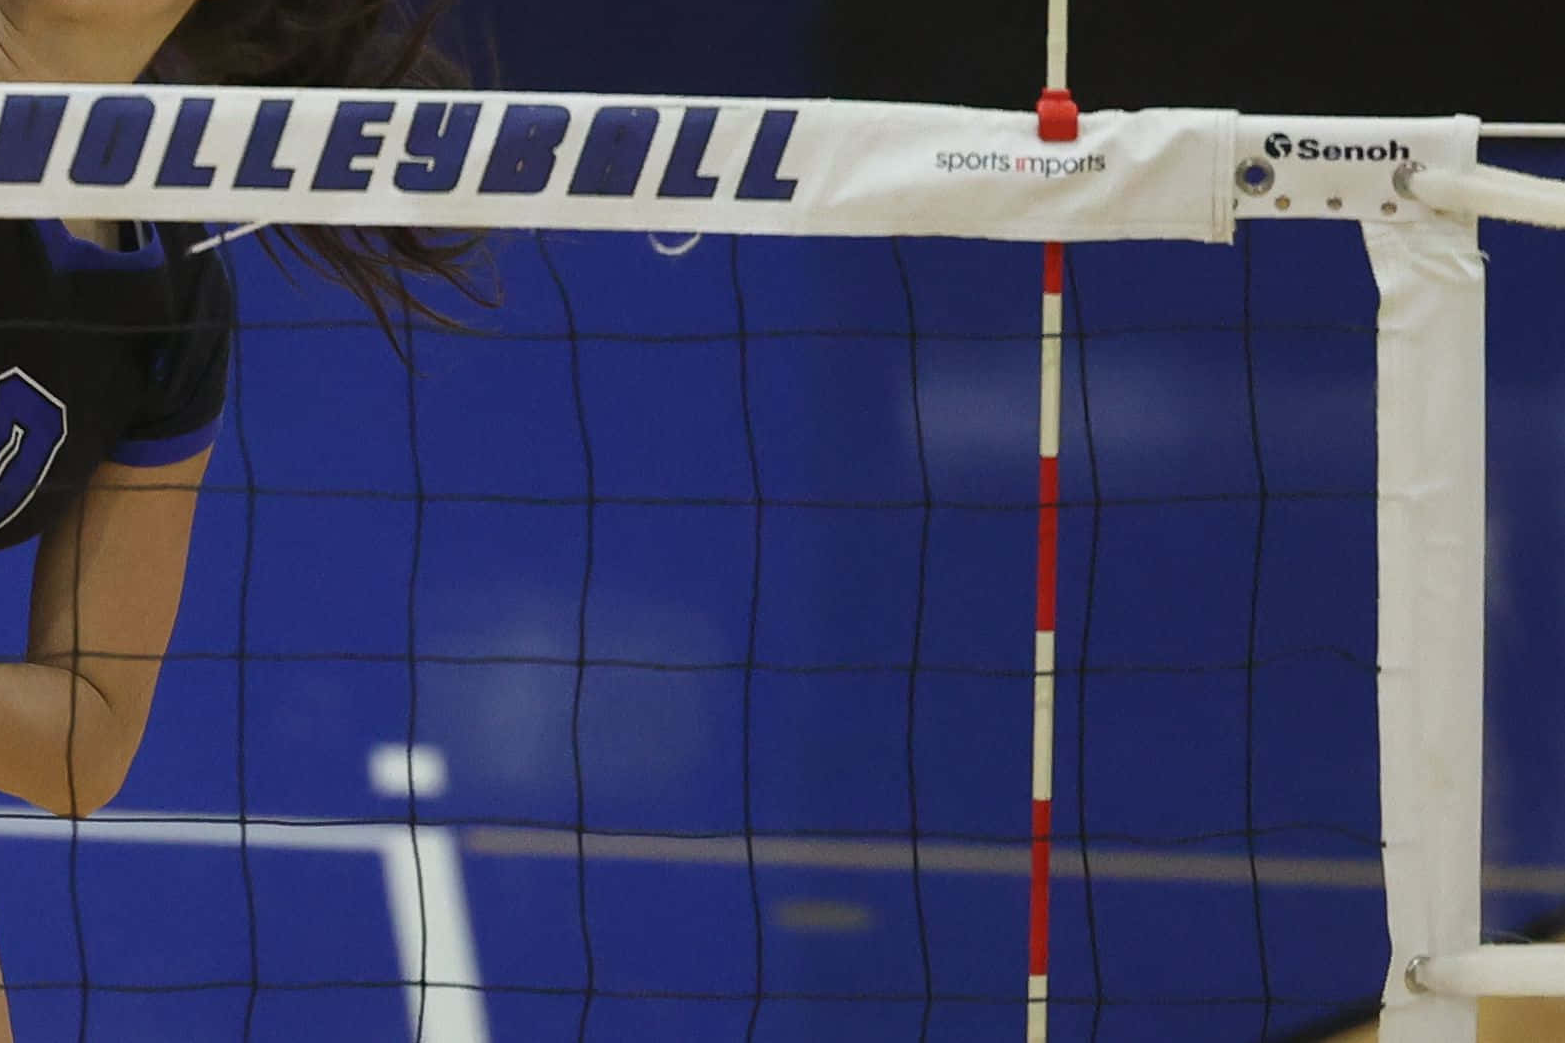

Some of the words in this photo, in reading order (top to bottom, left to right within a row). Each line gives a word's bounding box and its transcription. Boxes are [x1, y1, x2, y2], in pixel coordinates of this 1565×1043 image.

[1297, 138, 1410, 161] Senoh
[935, 151, 1010, 173] sports
[1015, 153, 1106, 178] imports
